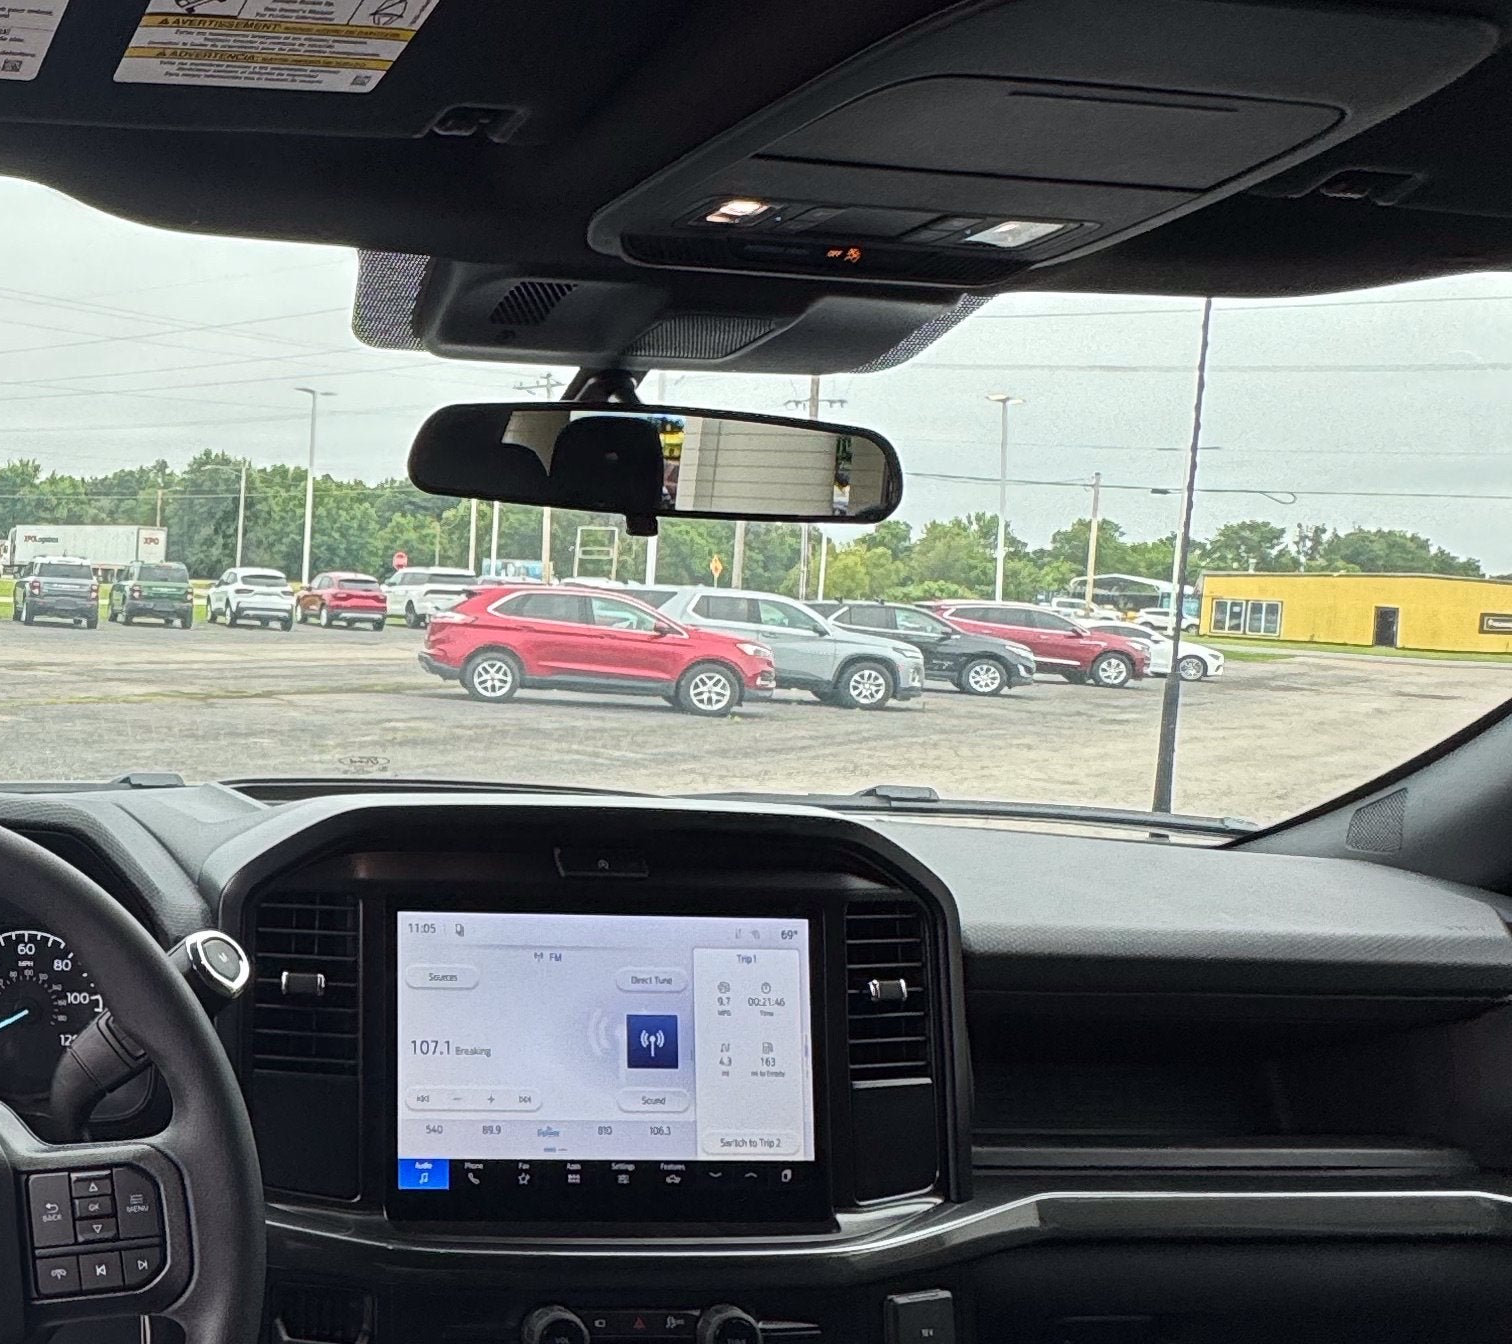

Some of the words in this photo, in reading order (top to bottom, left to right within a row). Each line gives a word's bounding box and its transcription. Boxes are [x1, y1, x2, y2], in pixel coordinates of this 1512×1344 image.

[144, 537, 159, 545] XPO
[408, 923, 437, 934] 11:05
[17, 943, 36, 955] 60
[549, 953, 563, 962] FM
[736, 954, 752, 965] Trip
[53, 959, 72, 971] 80
[631, 976, 653, 985] Direct
[655, 976, 672, 985] Tune
[66, 992, 90, 1004] 100
[59, 1033, 78, 1047] 12
[410, 1040, 451, 1056] 107.1
[760, 1057, 776, 1067] 163
[426, 1125, 444, 1135] 540
[720, 1138, 748, 1148] Switch
[749, 1139, 758, 1148] to
[759, 1139, 775, 1149] Trip
